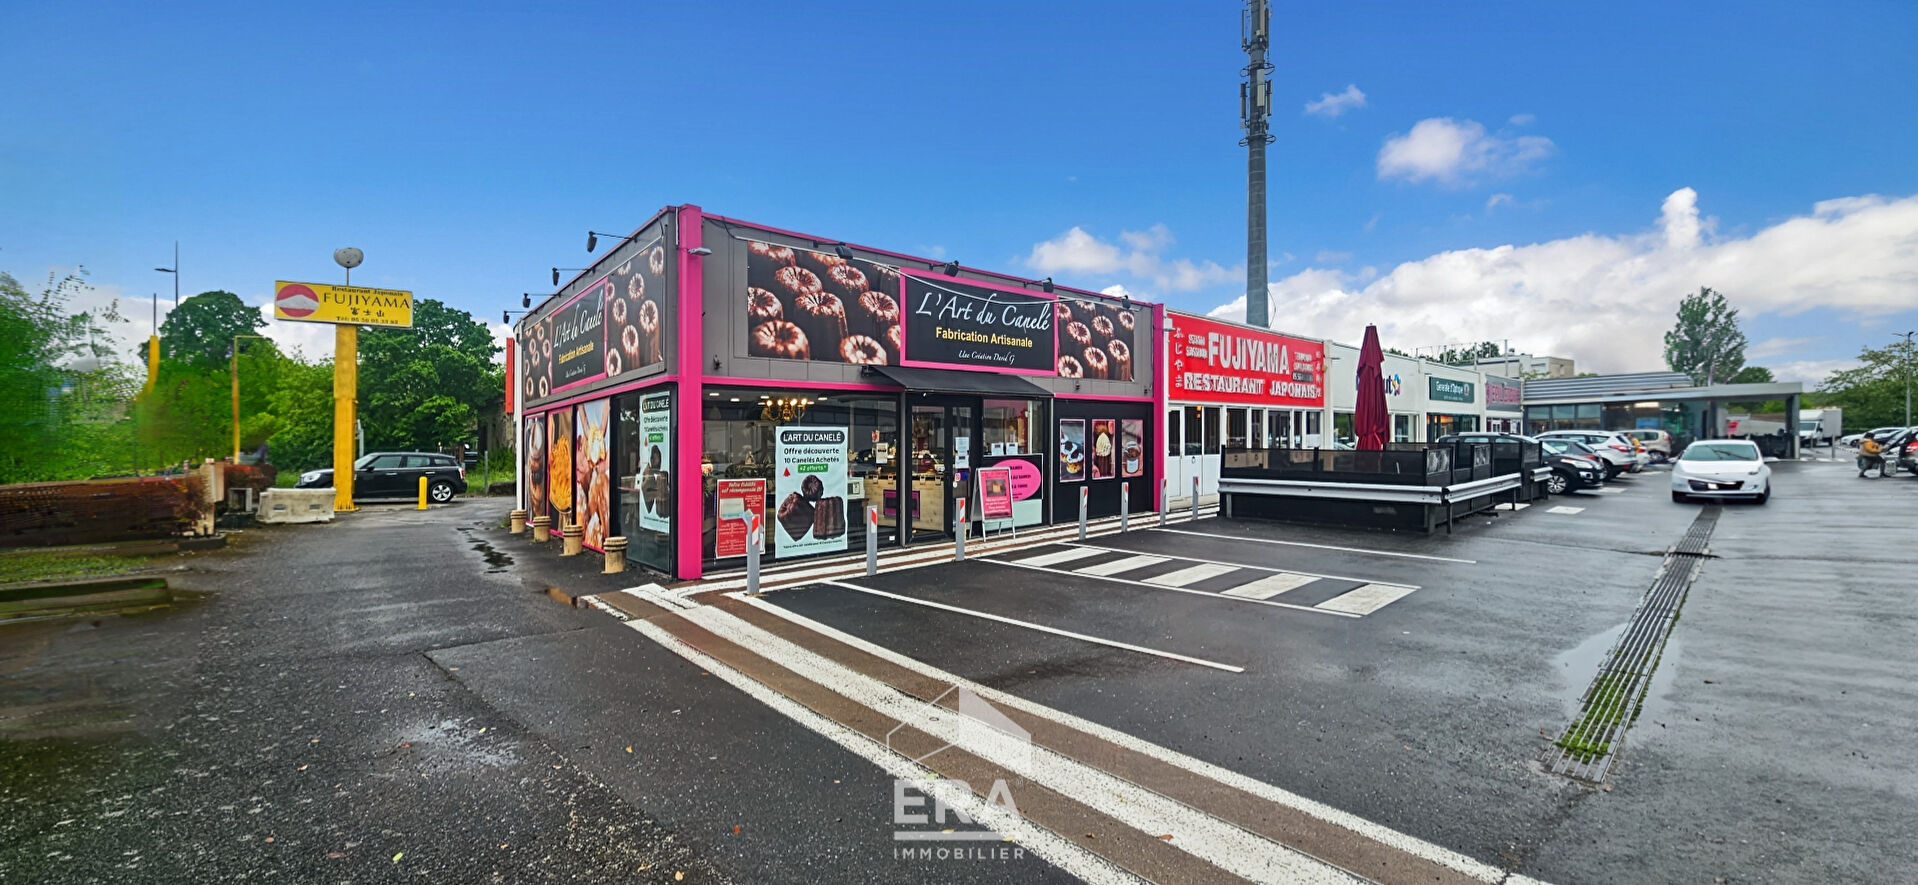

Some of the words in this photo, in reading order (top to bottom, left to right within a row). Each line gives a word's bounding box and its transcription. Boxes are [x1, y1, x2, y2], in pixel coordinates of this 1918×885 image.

[323, 292, 410, 309] FUJIYAMA
[916, 292, 973, 320] L'Art
[976, 293, 997, 325] du
[1002, 302, 1051, 334] Canelé
[936, 326, 989, 344] Fabrication
[990, 333, 1033, 348] Artisanale
[1208, 331, 1290, 375] FUJIYAMA
[1184, 372, 1265, 395] RESTAURANT
[1269, 381, 1317, 399] JAPONAIS
[783, 433, 802, 442] L'ART
[803, 433, 814, 442] DU
[814, 432, 841, 442] CANELÉ
[783, 447, 802, 455] Offre
